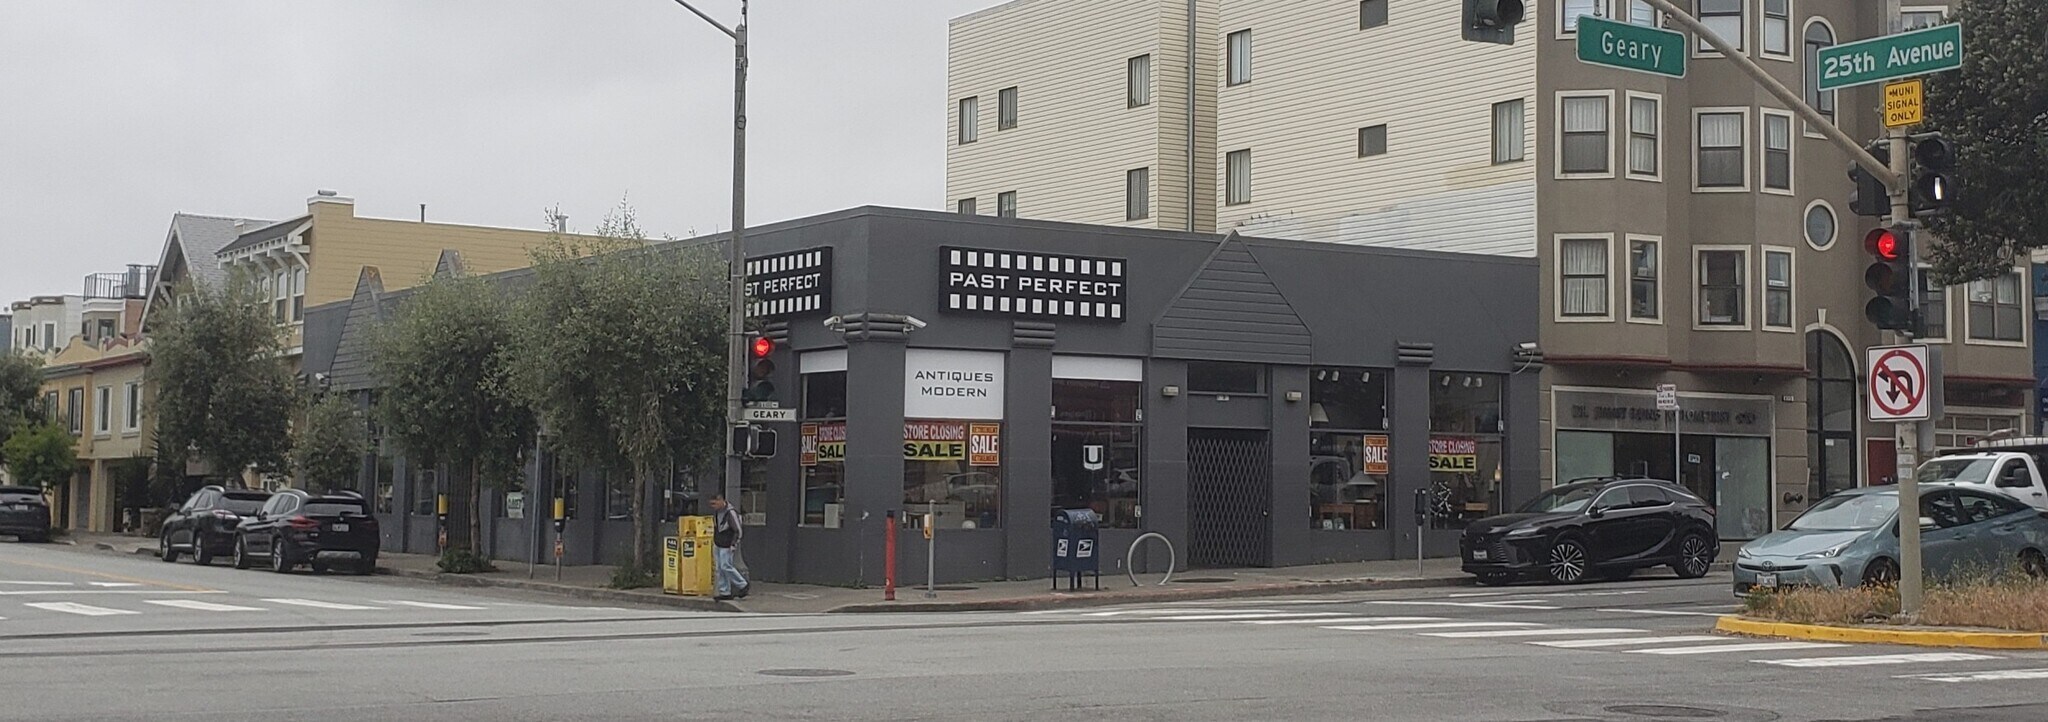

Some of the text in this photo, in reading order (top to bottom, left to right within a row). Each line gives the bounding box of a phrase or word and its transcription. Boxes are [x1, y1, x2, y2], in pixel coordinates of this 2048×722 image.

[1601, 31, 1662, 68] Geary
[1824, 40, 1954, 79] 25th Avenue
[1892, 86, 1914, 97] MUNI
[1887, 98, 1919, 110] SIGNAL
[1890, 111, 1916, 122] ONLY
[745, 273, 821, 297] ST PERFECT
[950, 272, 1121, 297] PAST PERFECT
[915, 371, 993, 383] ANTIQUES
[921, 386, 987, 397] MODERN
[753, 410, 786, 419] GEARY
[904, 424, 964, 440] STORE CLOSING
[904, 443, 962, 457] SALE
[971, 434, 998, 454] SALE
[1365, 446, 1388, 463] SALE
[1429, 456, 1474, 469] SALE
